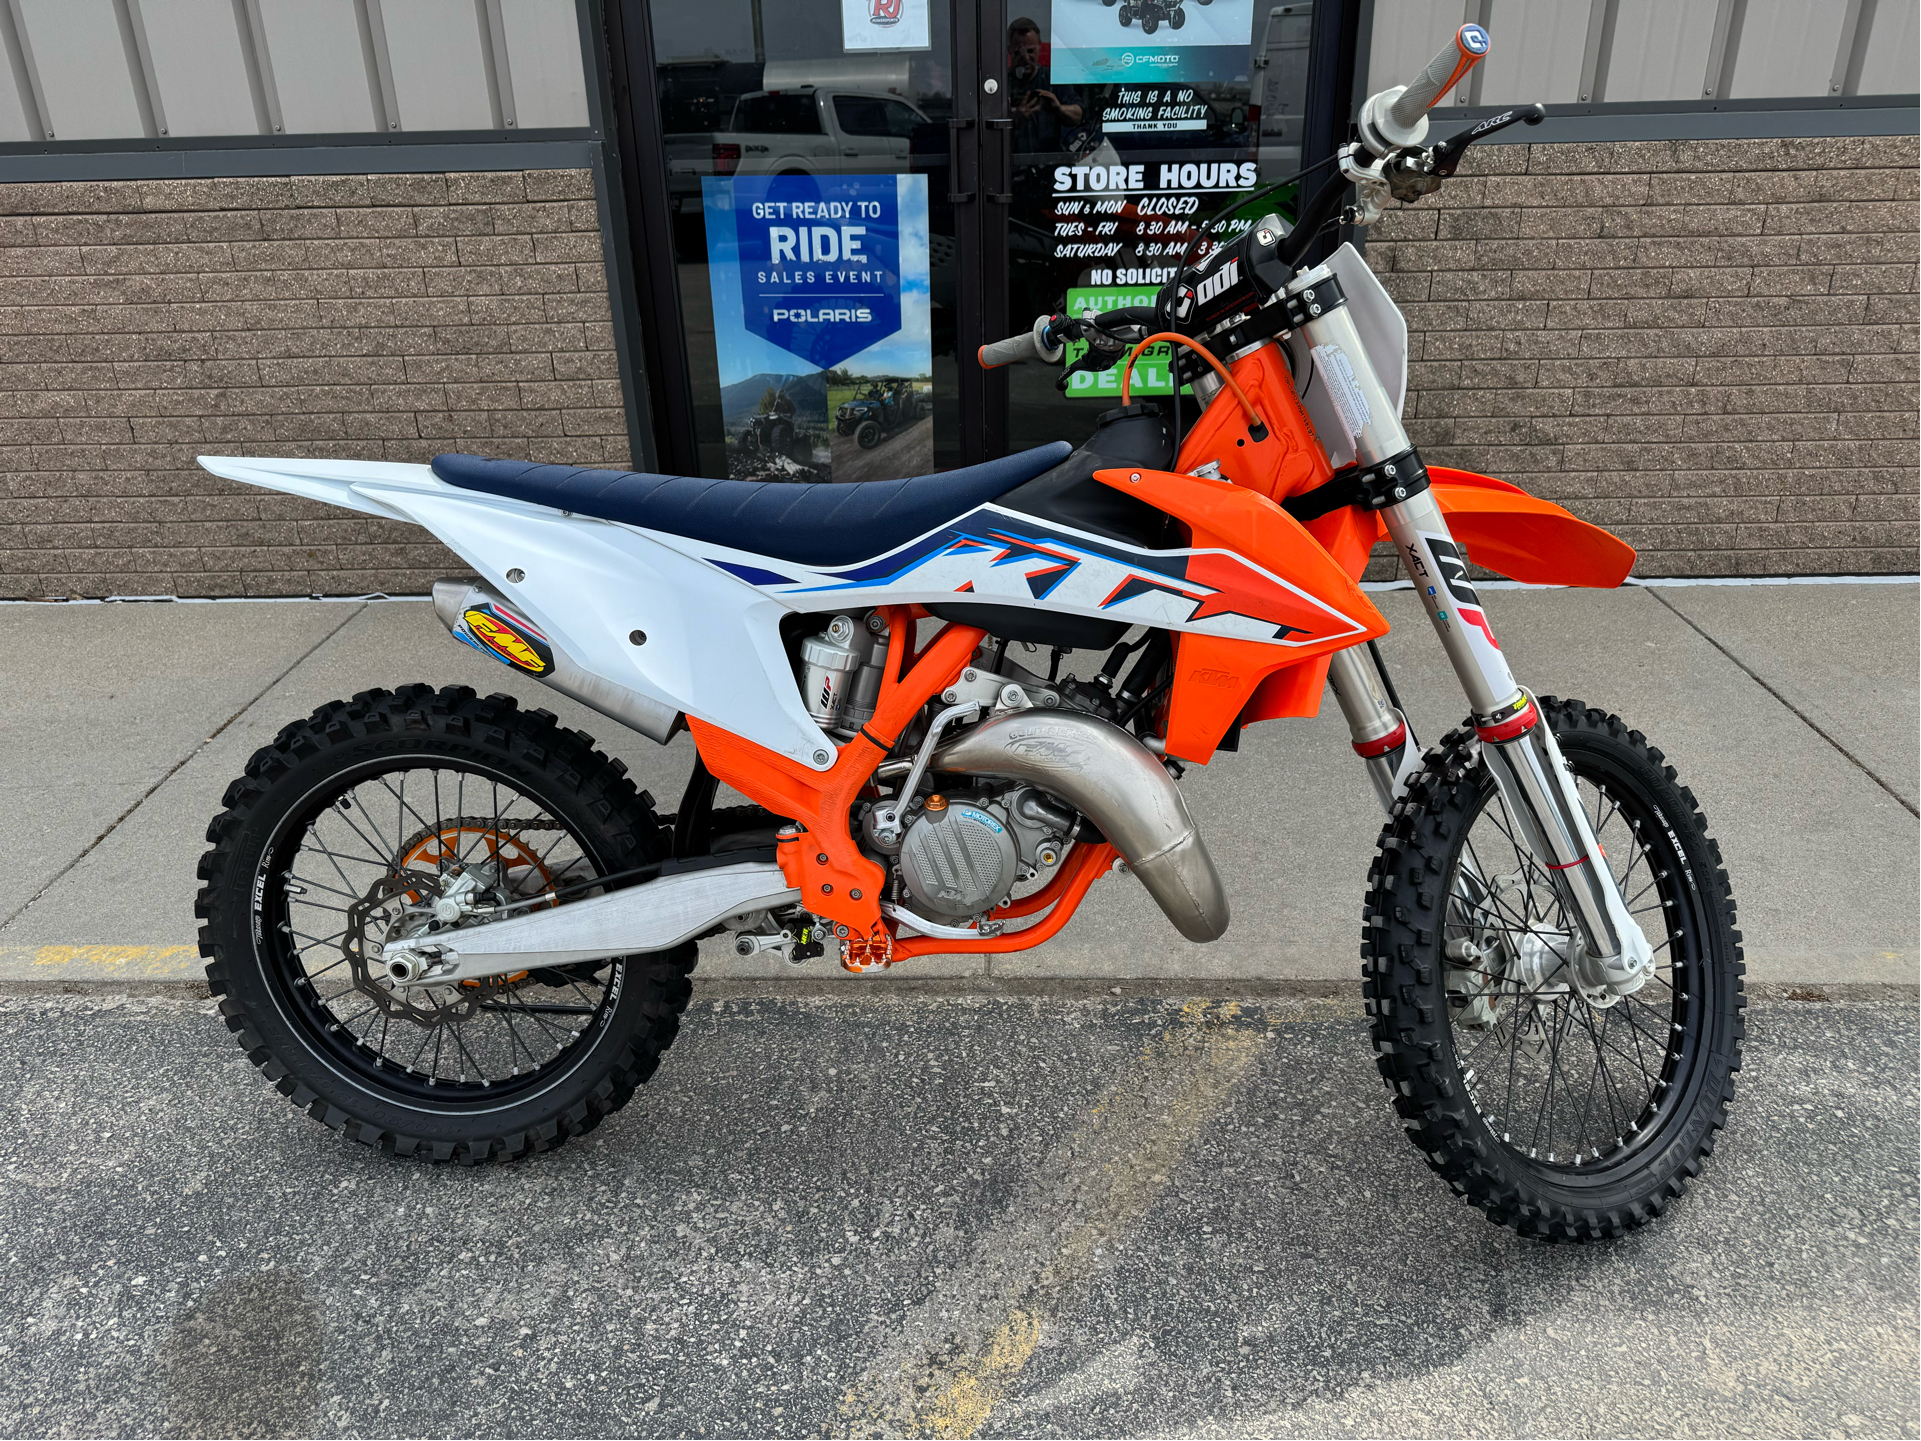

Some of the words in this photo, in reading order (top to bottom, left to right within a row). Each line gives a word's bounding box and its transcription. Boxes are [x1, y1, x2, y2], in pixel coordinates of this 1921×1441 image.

[1136, 55, 1179, 63] CFMOTO
[1117, 90, 1142, 104] THIS
[1146, 90, 1159, 103] IS
[1163, 90, 1171, 102] A
[1176, 89, 1194, 102] NO
[1102, 106, 1153, 121] SMOKING
[1157, 105, 1208, 118] FACILITY
[1471, 110, 1513, 135] ARC
[1053, 165, 1145, 191] STORE
[1159, 162, 1258, 189] HOURS
[752, 202, 787, 219] GET
[792, 201, 853, 219] READY
[857, 201, 881, 218] TO
[1054, 201, 1081, 216] SUN
[1093, 199, 1127, 215] MON
[1136, 196, 1200, 216] CLOSED
[1054, 222, 1085, 236] TUES
[1095, 222, 1118, 235] FRI
[1163, 220, 1188, 235] AM
[1227, 219, 1253, 233] PM
[769, 226, 867, 264] RIDE
[1054, 242, 1123, 258] SATURDAY
[1162, 241, 1188, 256] AM
[758, 271, 815, 283] SALES
[825, 271, 883, 283] EVENT
[1091, 269, 1113, 286] NO
[1116, 267, 1181, 285] SOLICIT
[1197, 257, 1239, 306] odi
[773, 309, 872, 322] POLARIS
[1071, 367, 1174, 389] DEAL
[1405, 543, 1429, 578] XACT
[462, 612, 546, 669] FMF
[351, 736, 533, 778] SCORPION
[971, 810, 1003, 834] MOTOREX
[1667, 829, 1688, 865] EXCEL
[253, 872, 267, 911] EXCEL
[608, 962, 622, 1000] EXCEL
[1652, 1068, 1722, 1180] DUNLOP
